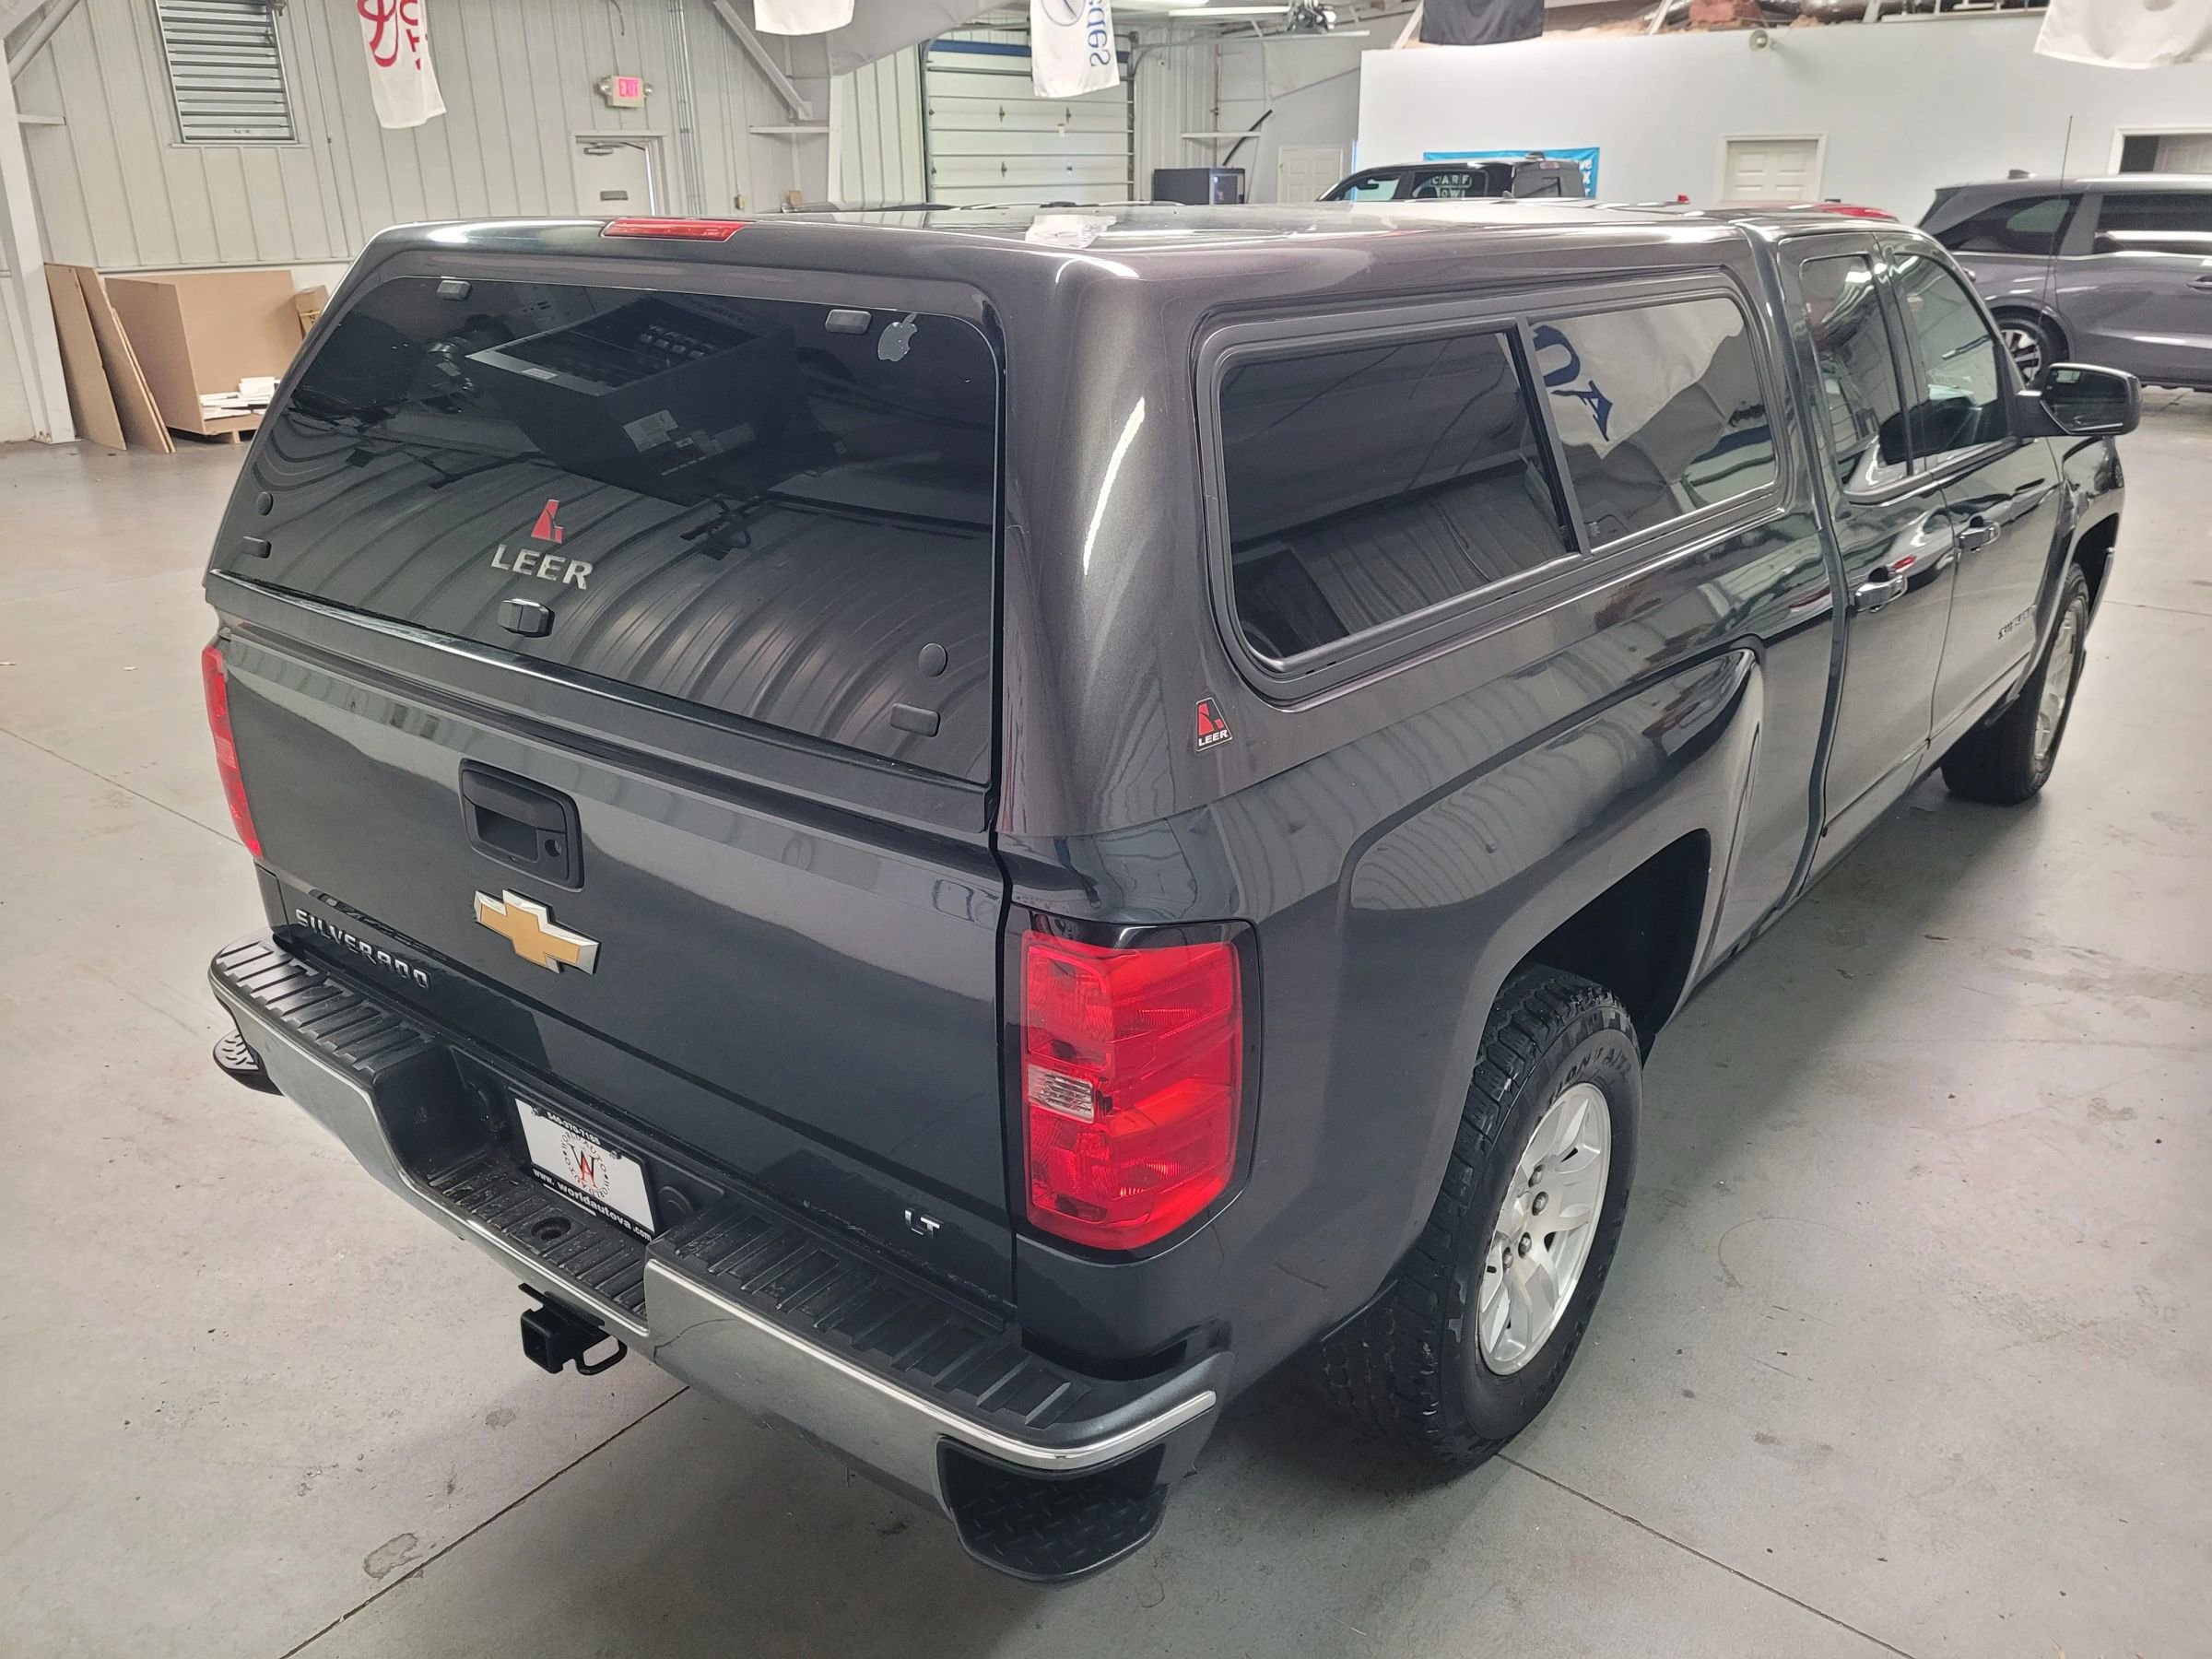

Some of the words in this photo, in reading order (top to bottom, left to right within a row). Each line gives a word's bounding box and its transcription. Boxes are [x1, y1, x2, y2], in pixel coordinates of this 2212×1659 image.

[618, 78, 639, 98] EXIT
[490, 543, 594, 590] LEER
[1198, 729, 1229, 747] LEER
[295, 908, 430, 989] SILVERADO
[904, 1209, 940, 1239] LT
